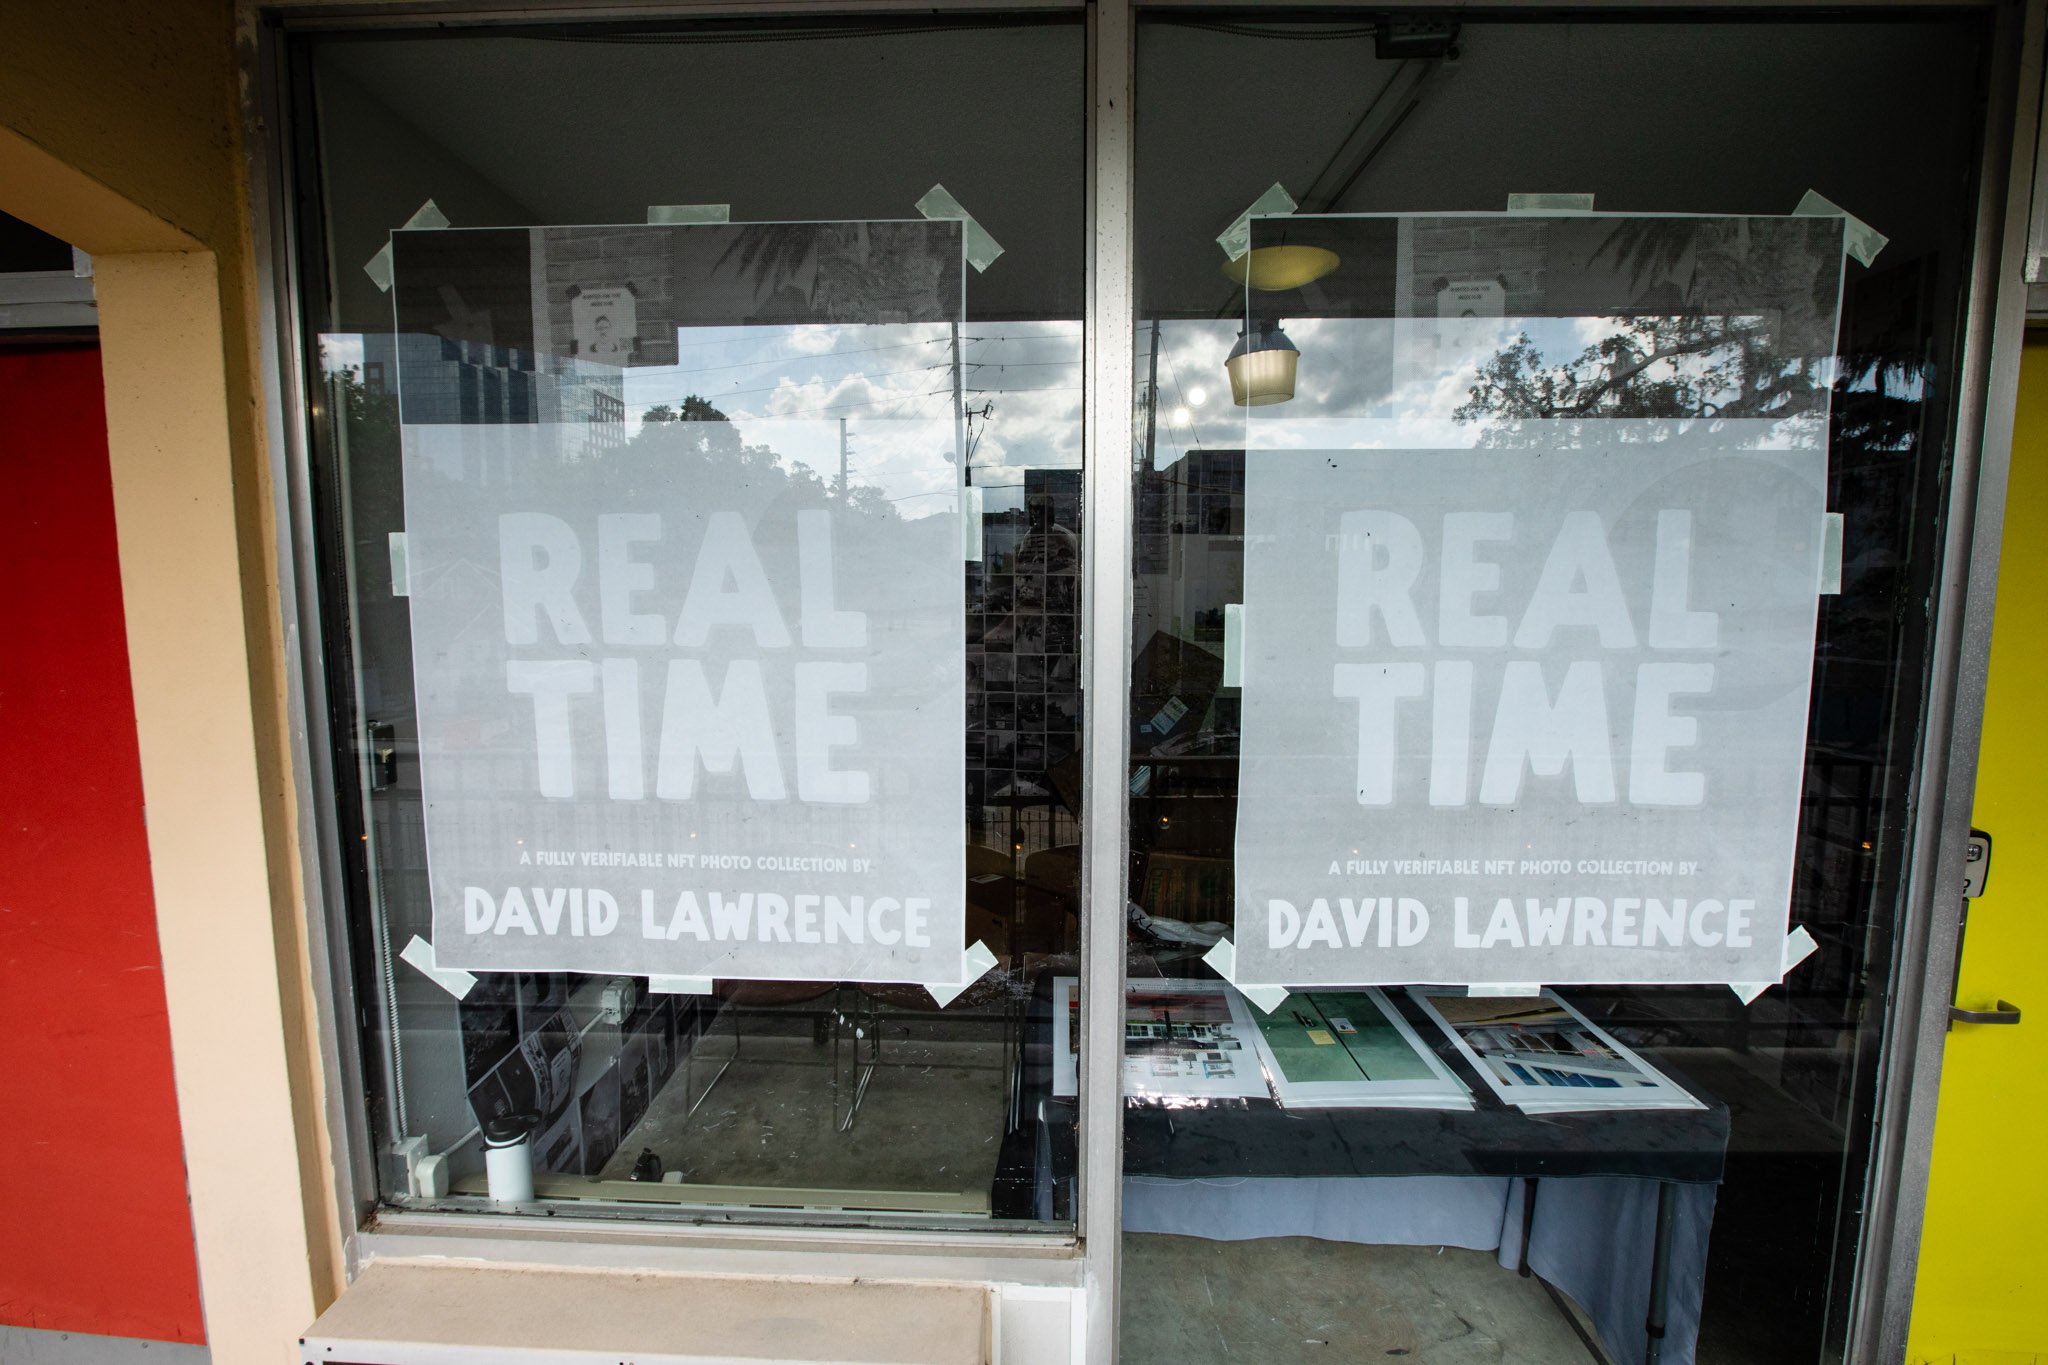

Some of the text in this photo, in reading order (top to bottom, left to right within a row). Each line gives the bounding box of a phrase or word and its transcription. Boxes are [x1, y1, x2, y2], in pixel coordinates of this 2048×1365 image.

[499, 509, 867, 647] REAL
[1336, 509, 1719, 649] REAL
[506, 658, 871, 803] TIME
[1333, 660, 1715, 807] TIME
[520, 851, 871, 873] A FULLY VERIFIABLE NFT PHOTO COLLECTION BY
[1328, 859, 1698, 876] A FULLY VERIFIABLE NFT PHOTO COLLECTION BY
[464, 886, 932, 947] DAVID LAWRENCE
[1268, 897, 1756, 949] DAVID LAWRENCE
